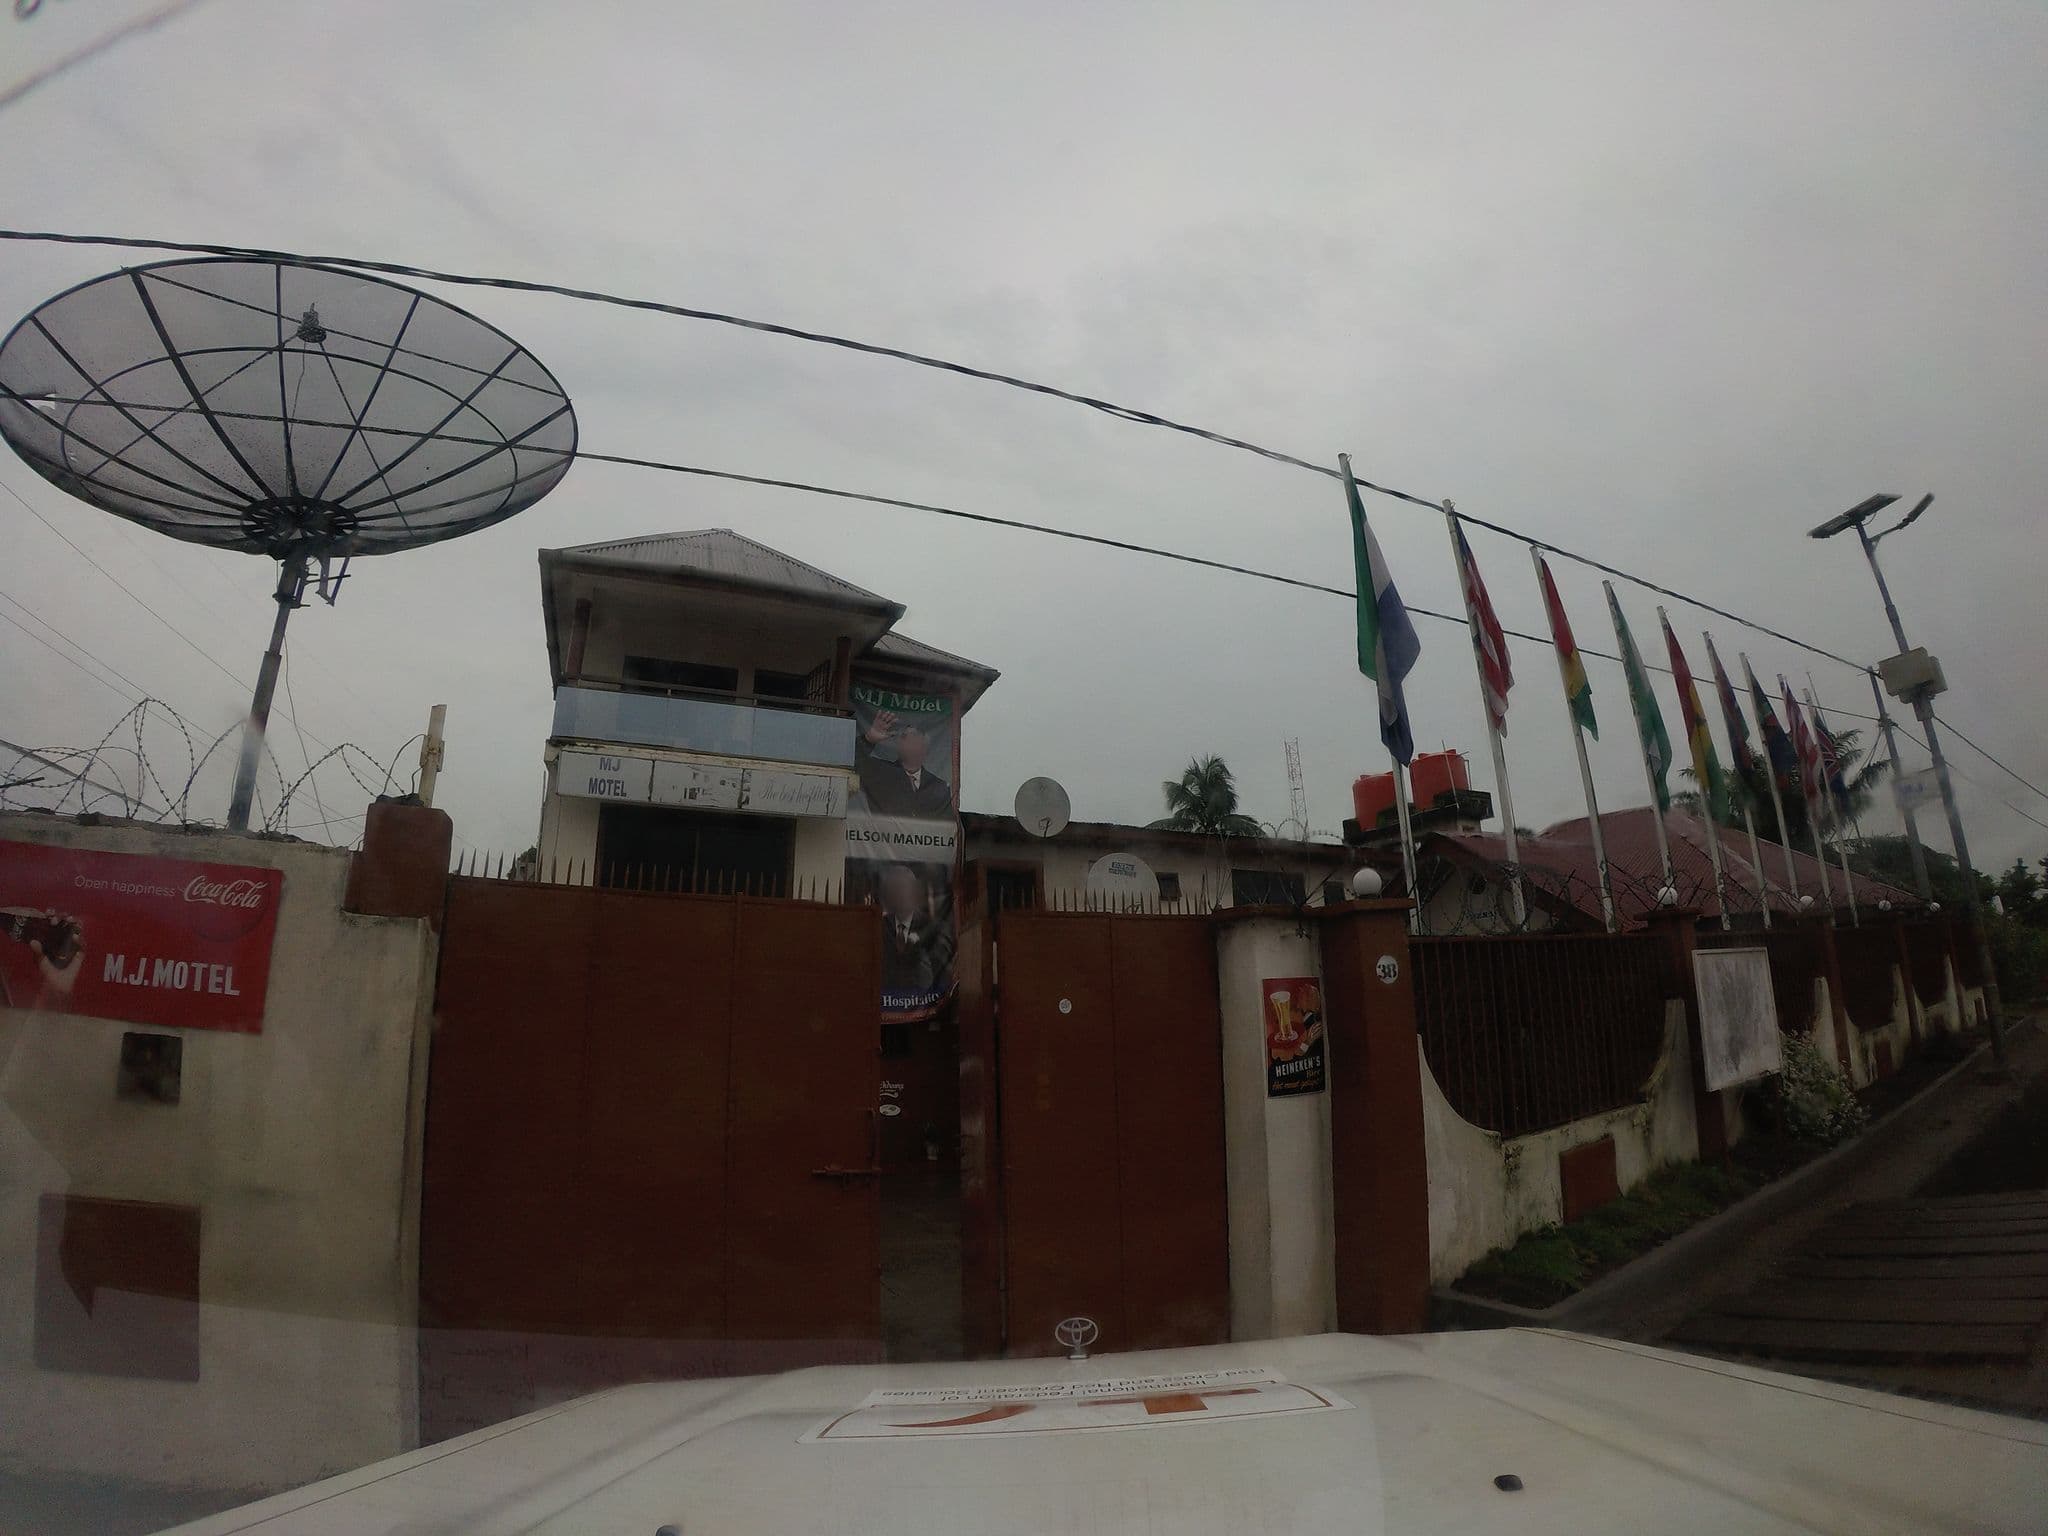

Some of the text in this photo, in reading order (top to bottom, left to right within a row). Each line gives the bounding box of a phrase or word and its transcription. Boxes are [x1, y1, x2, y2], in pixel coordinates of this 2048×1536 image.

[889, 692, 942, 712] Motel
[599, 756, 621, 773] MJ
[588, 776, 627, 797] MOTEL
[893, 832, 955, 847] MANDELA
[74, 874, 269, 909] Open happiness Coca-Cola
